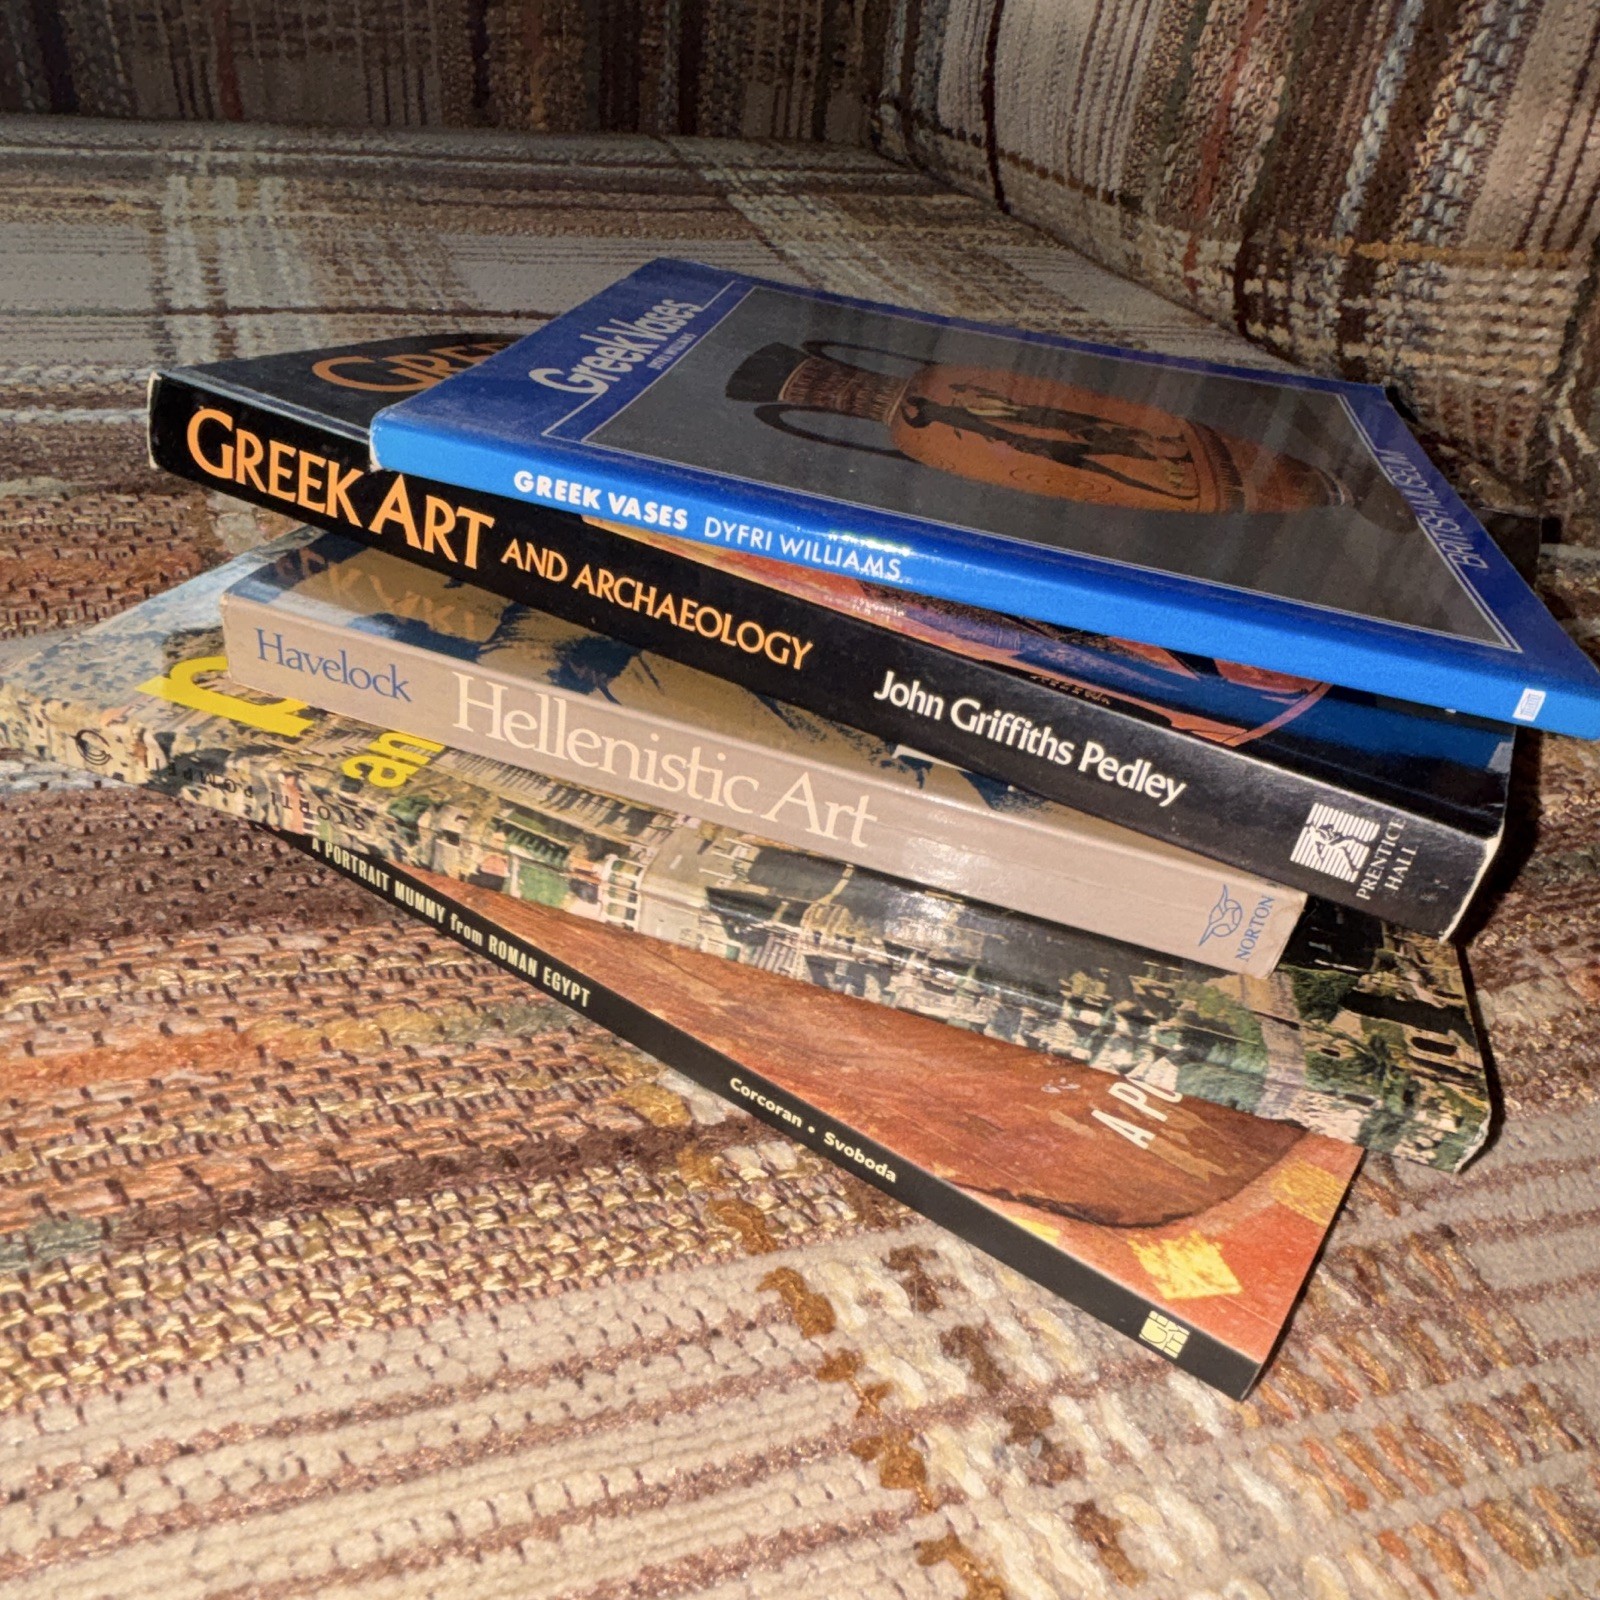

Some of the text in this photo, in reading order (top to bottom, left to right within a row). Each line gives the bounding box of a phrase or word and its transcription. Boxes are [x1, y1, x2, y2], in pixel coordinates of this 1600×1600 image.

[528, 333, 660, 394] Greek
[597, 299, 702, 341] Vases
[186, 408, 814, 671] GREEK ART AND ARCHAEOLOGY
[513, 470, 901, 583] GREEK VASES DYFRI WILLIAMS
[1413, 505, 1488, 569] BRITISH
[257, 627, 412, 702] Havelock
[452, 672, 759, 814] Hellenistic
[760, 771, 878, 848] Art
[873, 670, 1188, 808] John Griffiths Pedley
[1356, 817, 1407, 900] PRENTICE
[1384, 845, 1419, 891] HALL
[311, 837, 592, 1008] A PORTRAIT MUMMY from ROMAN EGYPT
[1235, 895, 1275, 962] NORTON
[730, 1077, 896, 1183] Corcoran Svoboda
